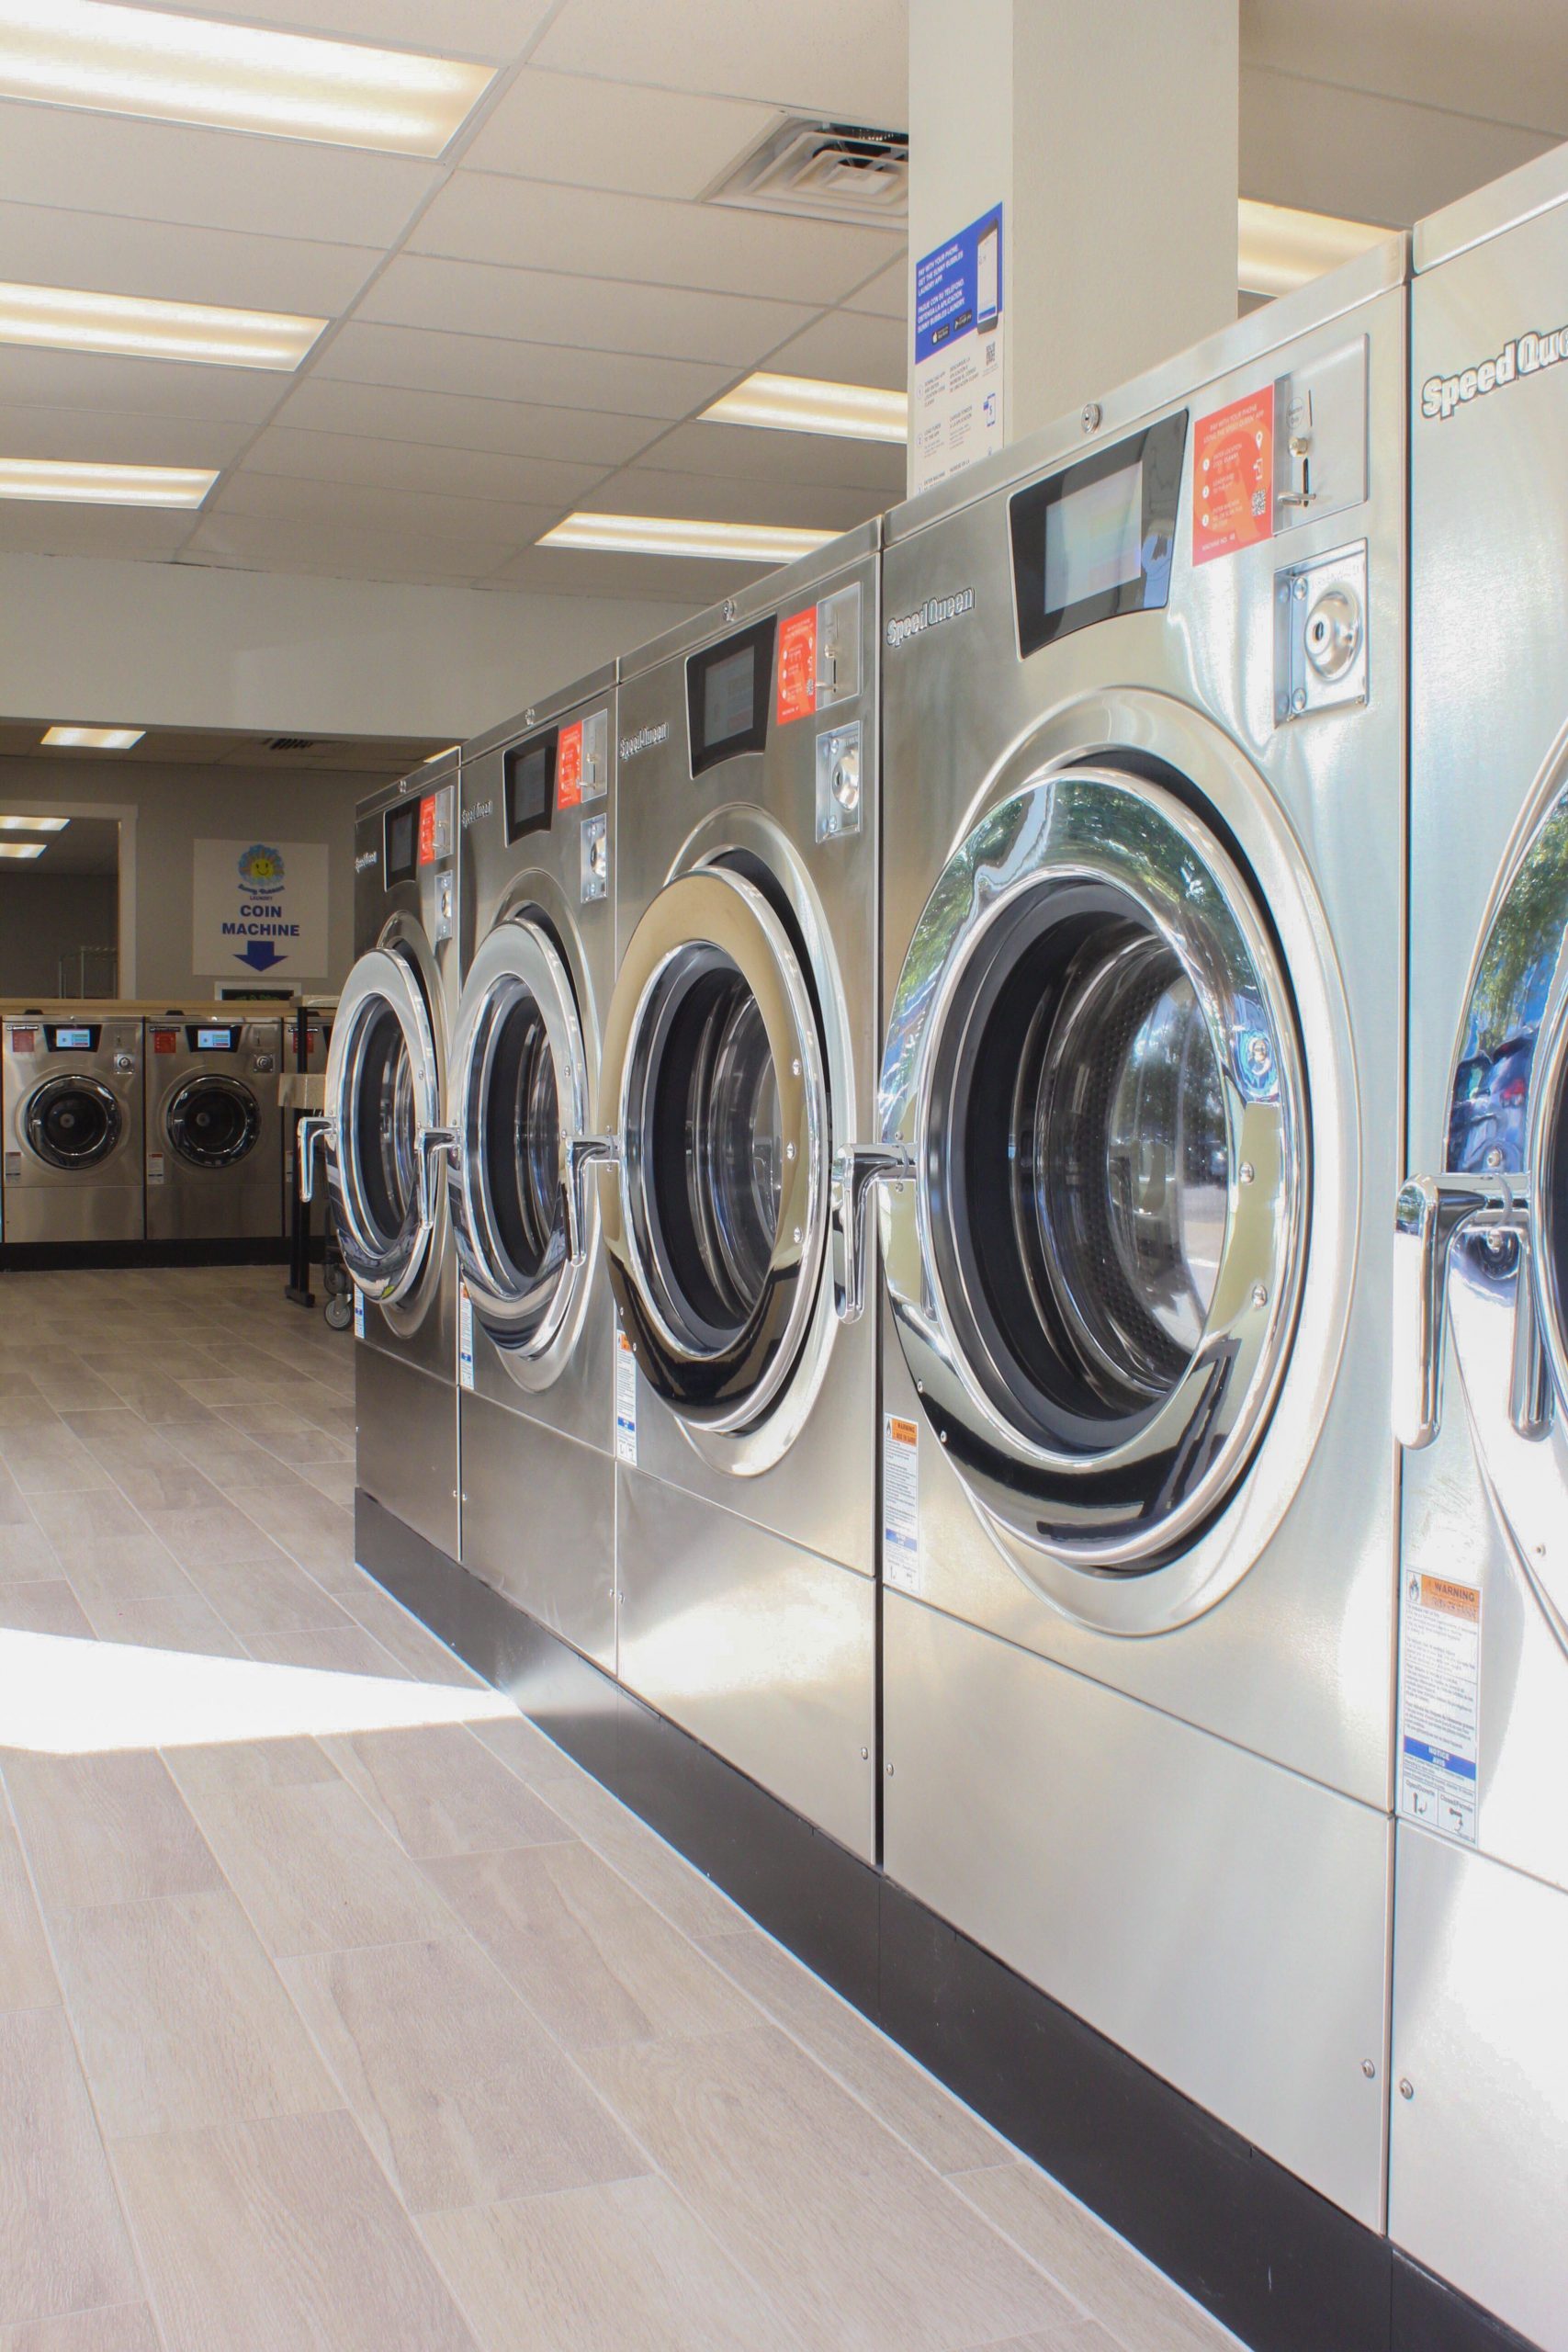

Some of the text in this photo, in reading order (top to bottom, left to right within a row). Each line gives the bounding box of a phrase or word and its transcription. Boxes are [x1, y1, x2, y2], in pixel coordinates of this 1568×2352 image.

[1421, 338, 1517, 422] Speed
[886, 587, 975, 648] Speed Queen
[619, 722, 669, 762] Speed Queen
[240, 905, 282, 918] COIN
[222, 922, 300, 937] MACHINE
[1434, 1581, 1475, 1602] WARNING
[1428, 1745, 1450, 1761] NOTICE
